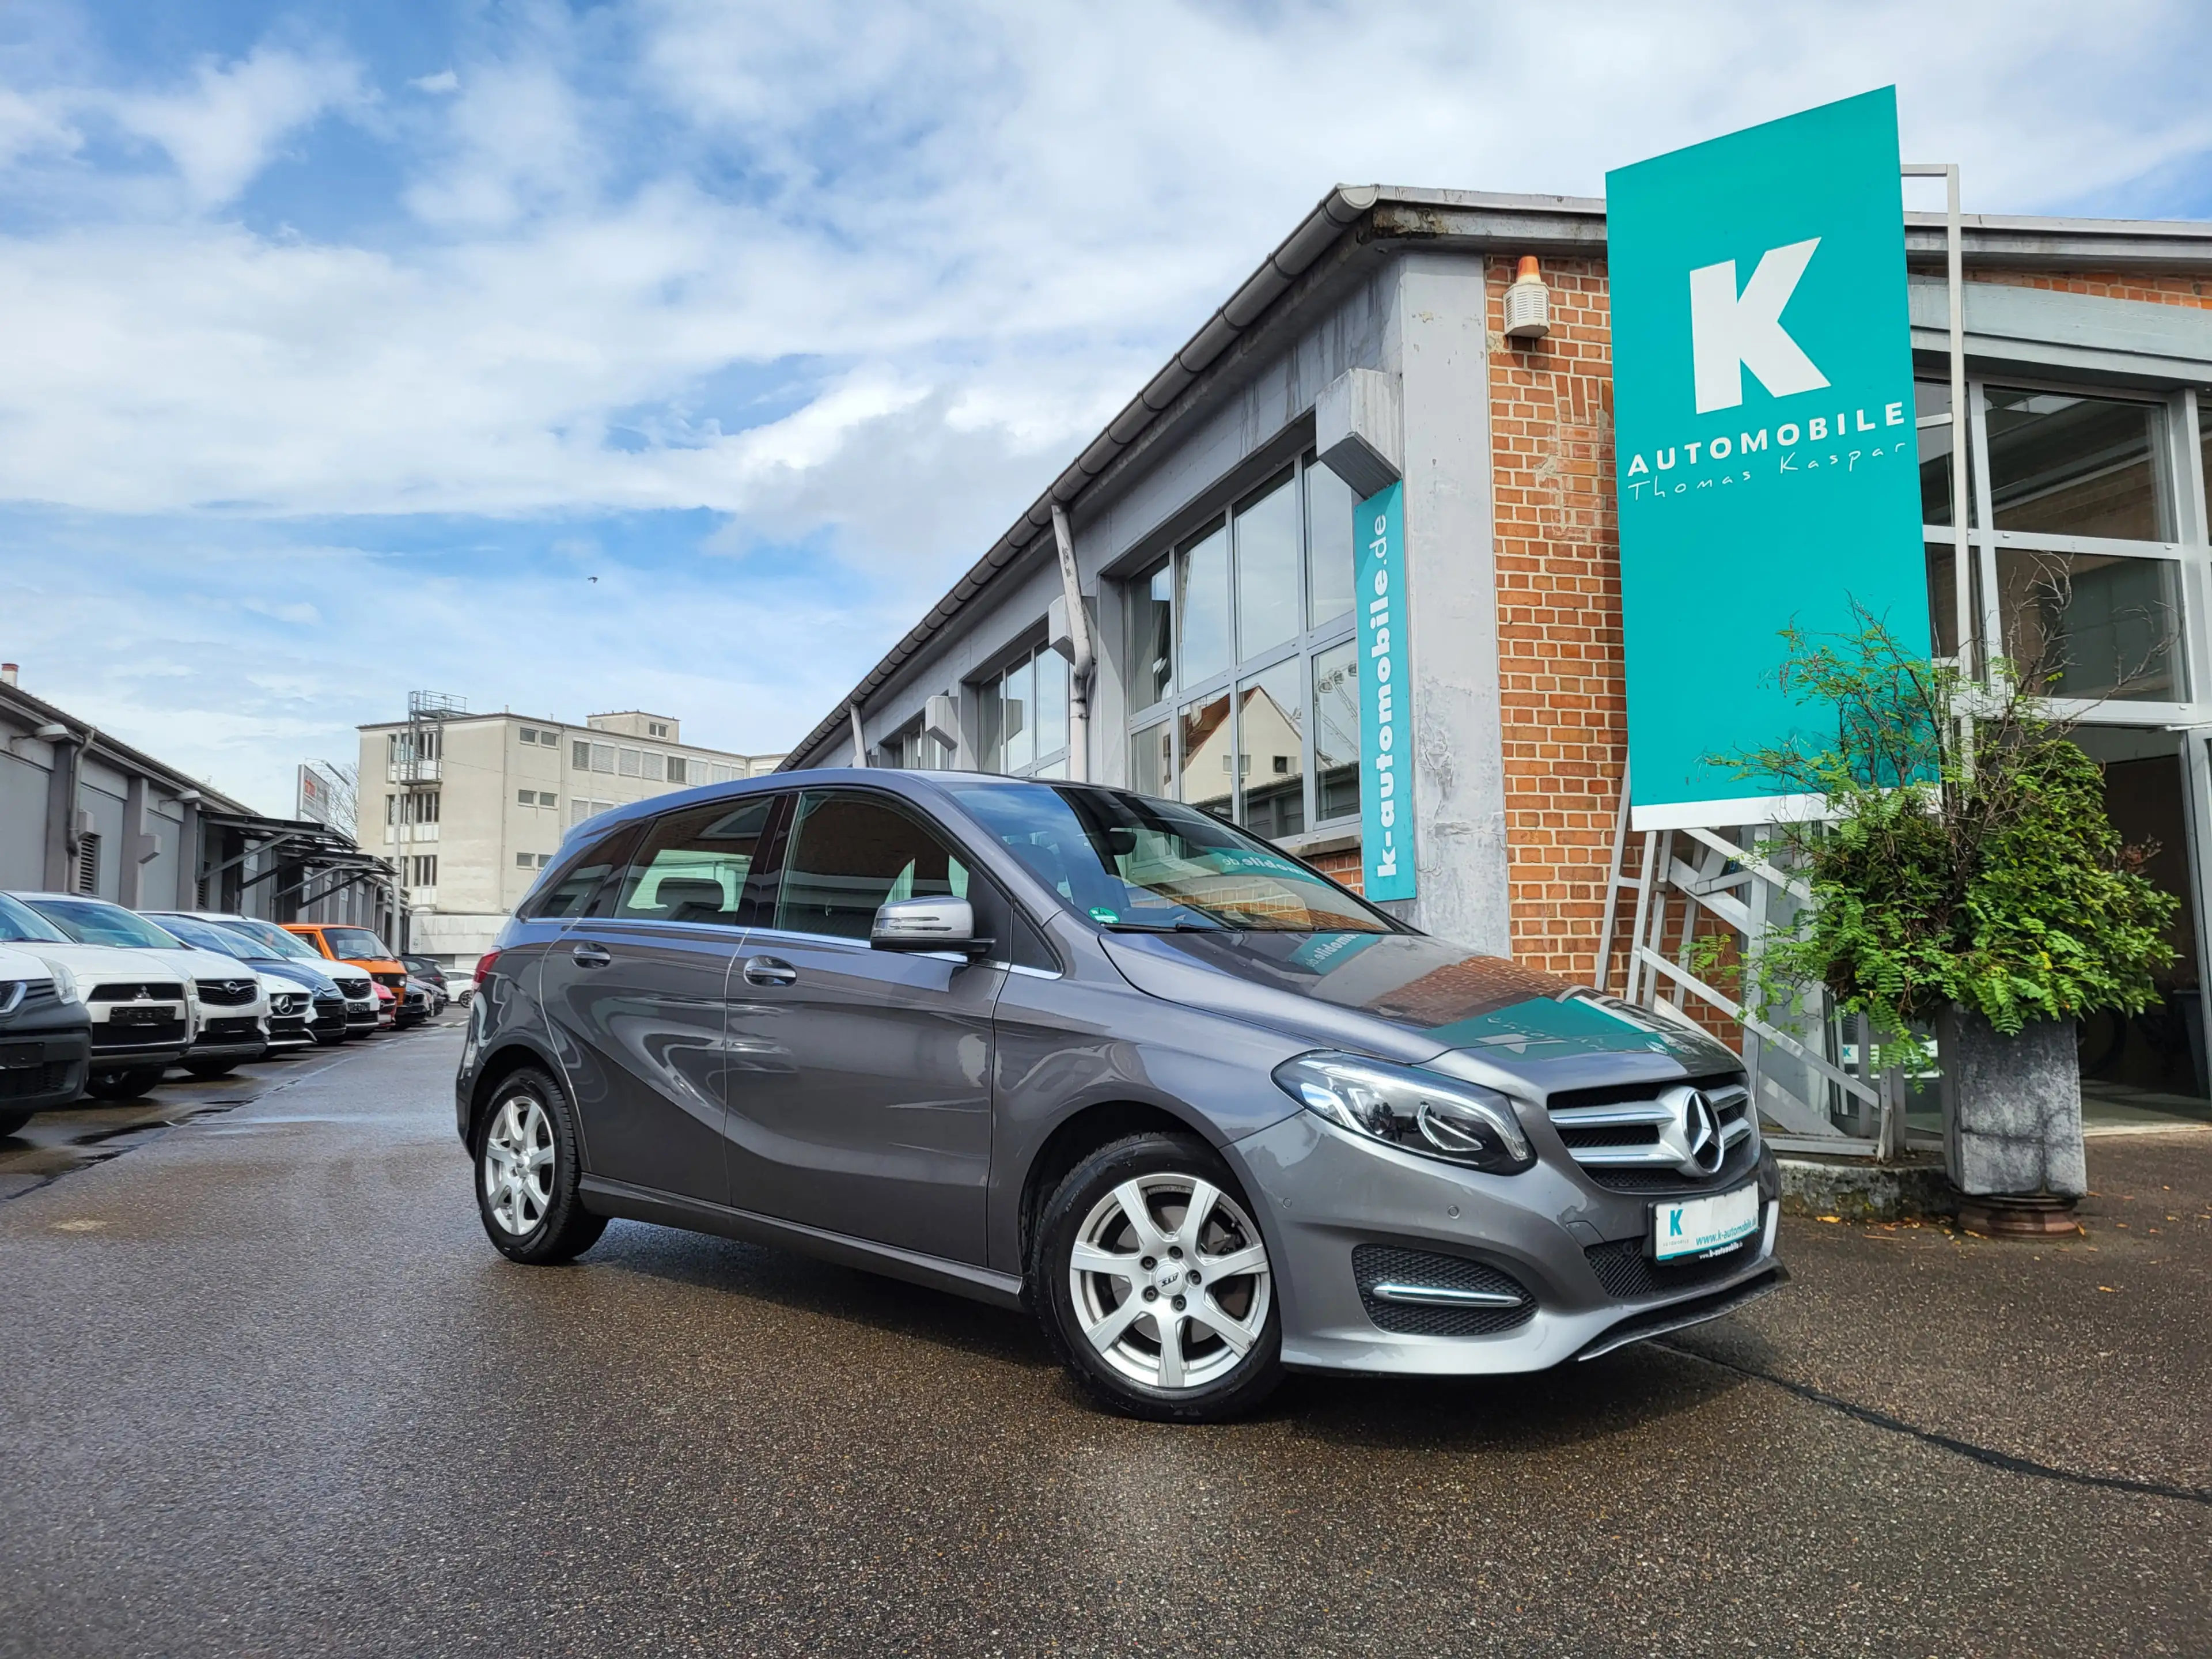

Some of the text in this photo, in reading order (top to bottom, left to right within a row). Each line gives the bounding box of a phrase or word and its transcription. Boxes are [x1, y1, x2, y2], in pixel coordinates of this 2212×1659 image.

[1690, 237, 1832, 415] K
[1627, 402, 1905, 476] AUTOMOBILE
[1627, 443, 1906, 501] Thomas Kaspar
[1369, 514, 1397, 877] k-automobile.de
[1670, 1209, 1684, 1237] K
